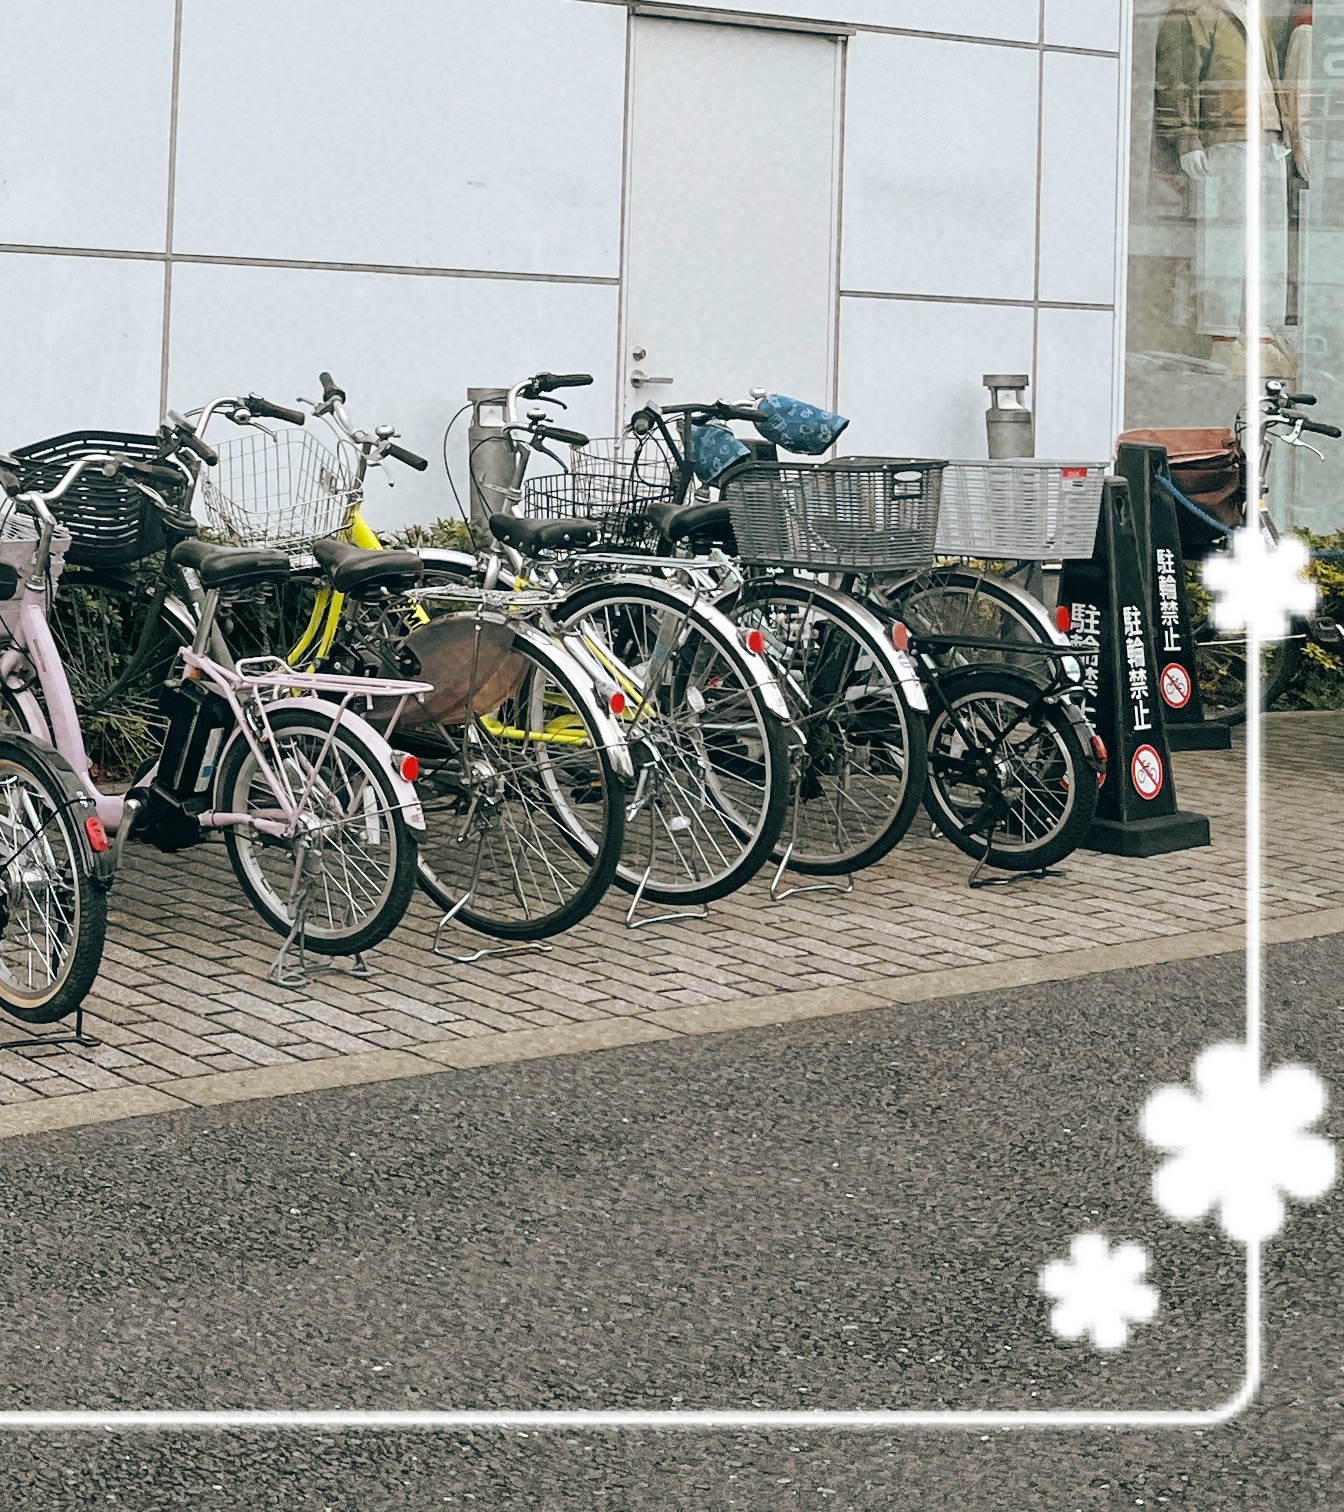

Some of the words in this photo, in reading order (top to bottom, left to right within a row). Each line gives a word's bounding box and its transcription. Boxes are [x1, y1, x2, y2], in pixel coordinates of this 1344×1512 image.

[1157, 548, 1182, 652] 駐輪禁止
[1122, 605, 1152, 731] 駐輪禁止
